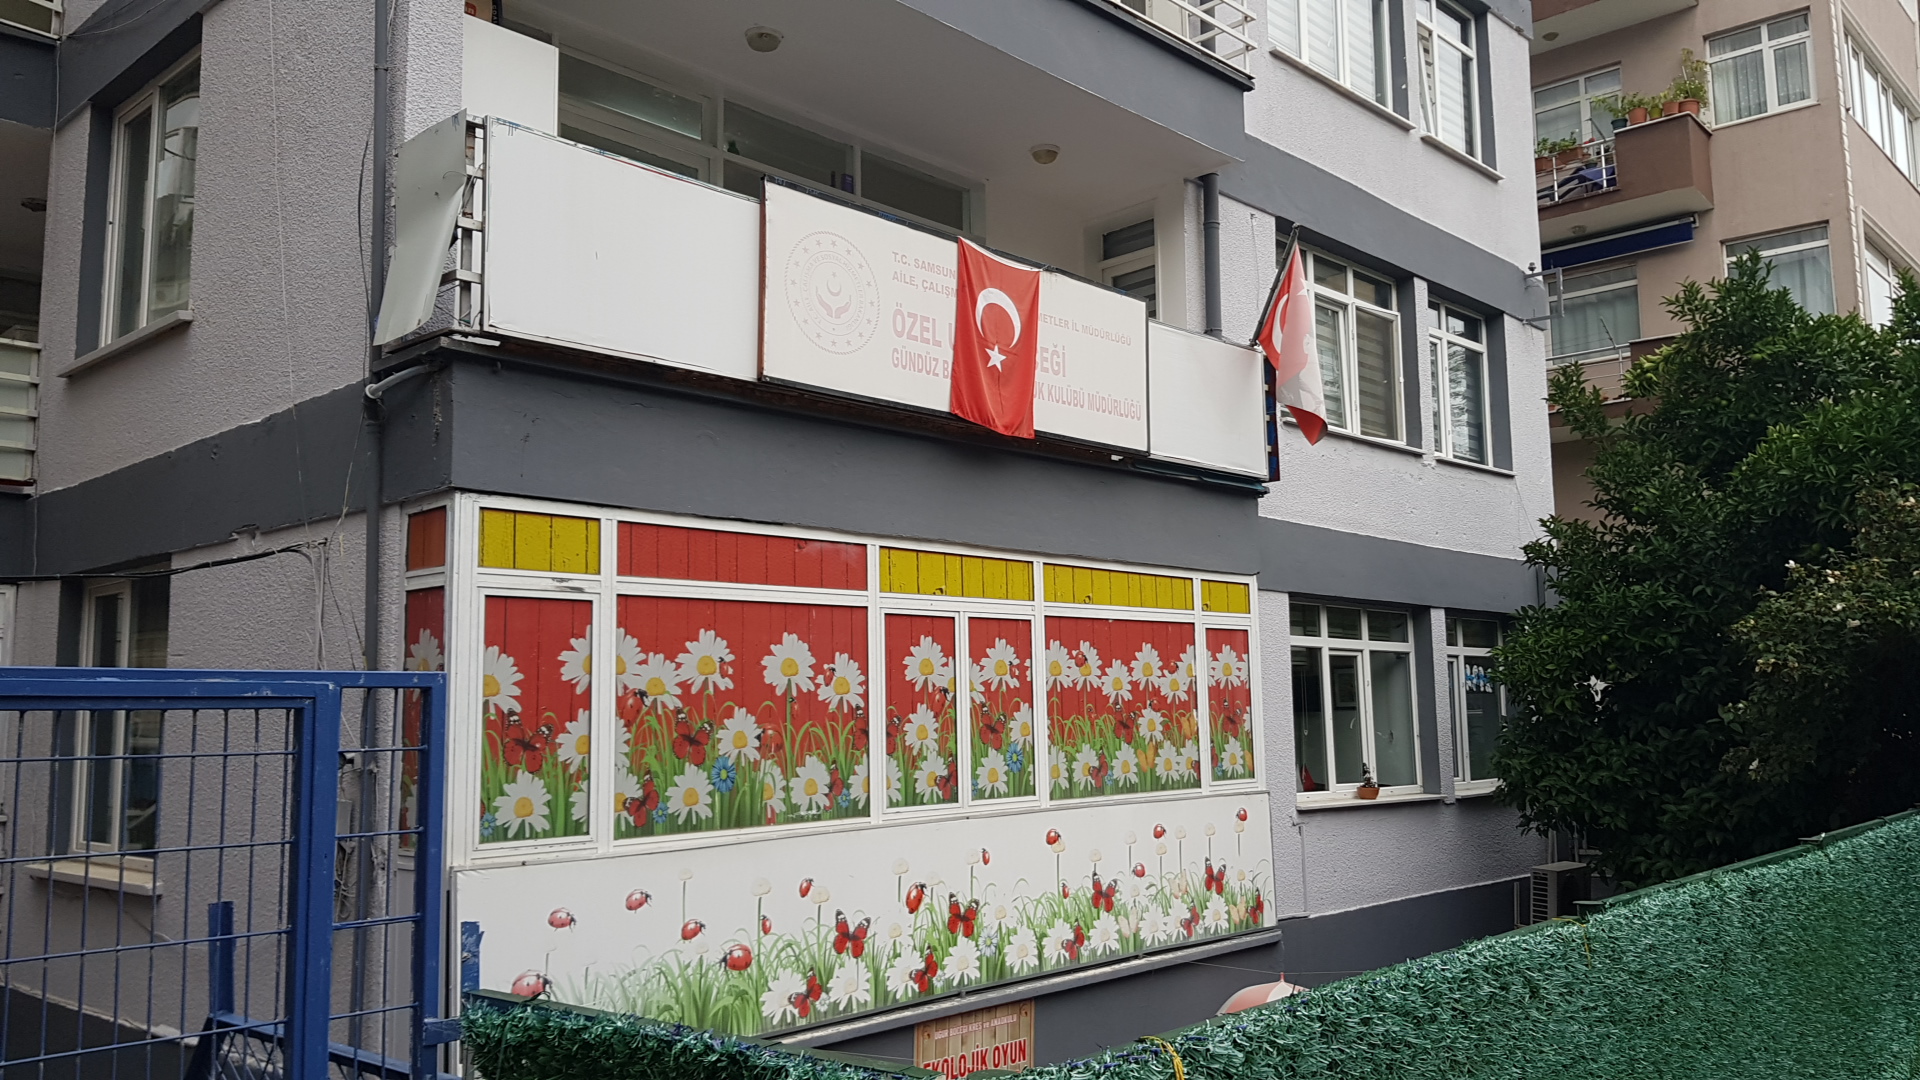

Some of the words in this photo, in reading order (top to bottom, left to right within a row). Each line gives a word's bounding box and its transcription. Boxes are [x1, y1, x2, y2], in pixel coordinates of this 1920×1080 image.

[892, 251, 911, 267] T.C.
[913, 258, 956, 280] SAMSUN
[892, 270, 919, 290] AİLE,
[921, 279, 957, 298] ÇALIŞM
[1071, 319, 1080, 333] İL
[1081, 324, 1132, 346] MÜDÜRLÜĞÜ
[892, 301, 942, 348] ÖZEL
[1037, 343, 1067, 378] EĞİ
[891, 345, 939, 377] GÜNDÜZ
[1047, 383, 1085, 409] KULÜBÜ
[1087, 391, 1142, 421] MÜDÜRLÜĞÜ
[992, 1038, 1027, 1069] OYUN
